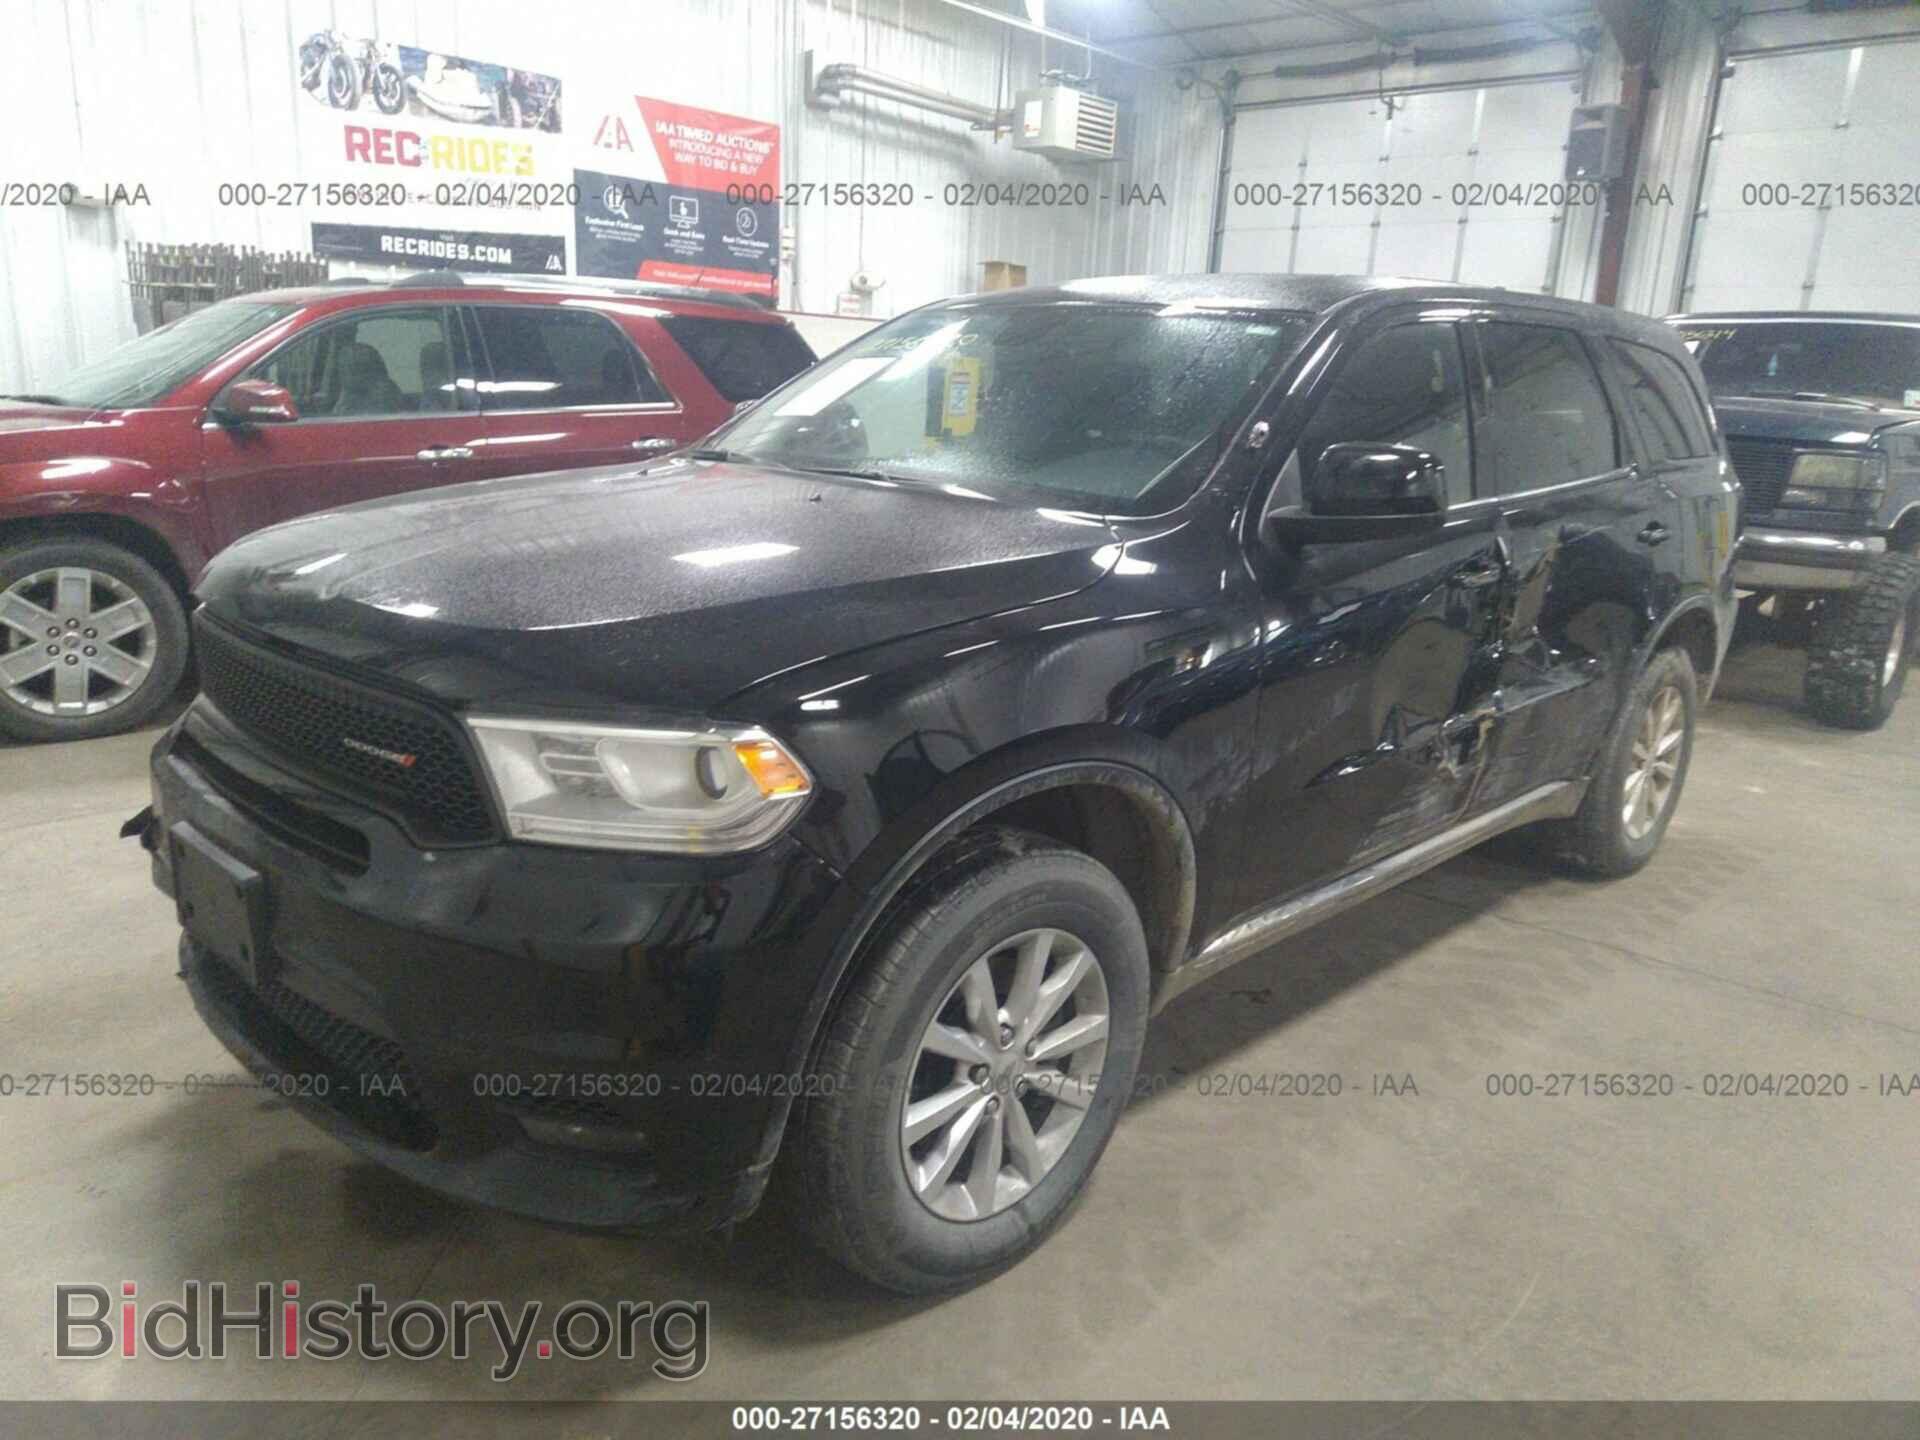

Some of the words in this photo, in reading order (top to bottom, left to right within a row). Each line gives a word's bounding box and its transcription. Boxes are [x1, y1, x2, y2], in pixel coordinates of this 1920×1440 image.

[344, 124, 422, 167] REC
[430, 135, 535, 176] RIDES
[380, 235, 512, 264] RECRIDES.COM
